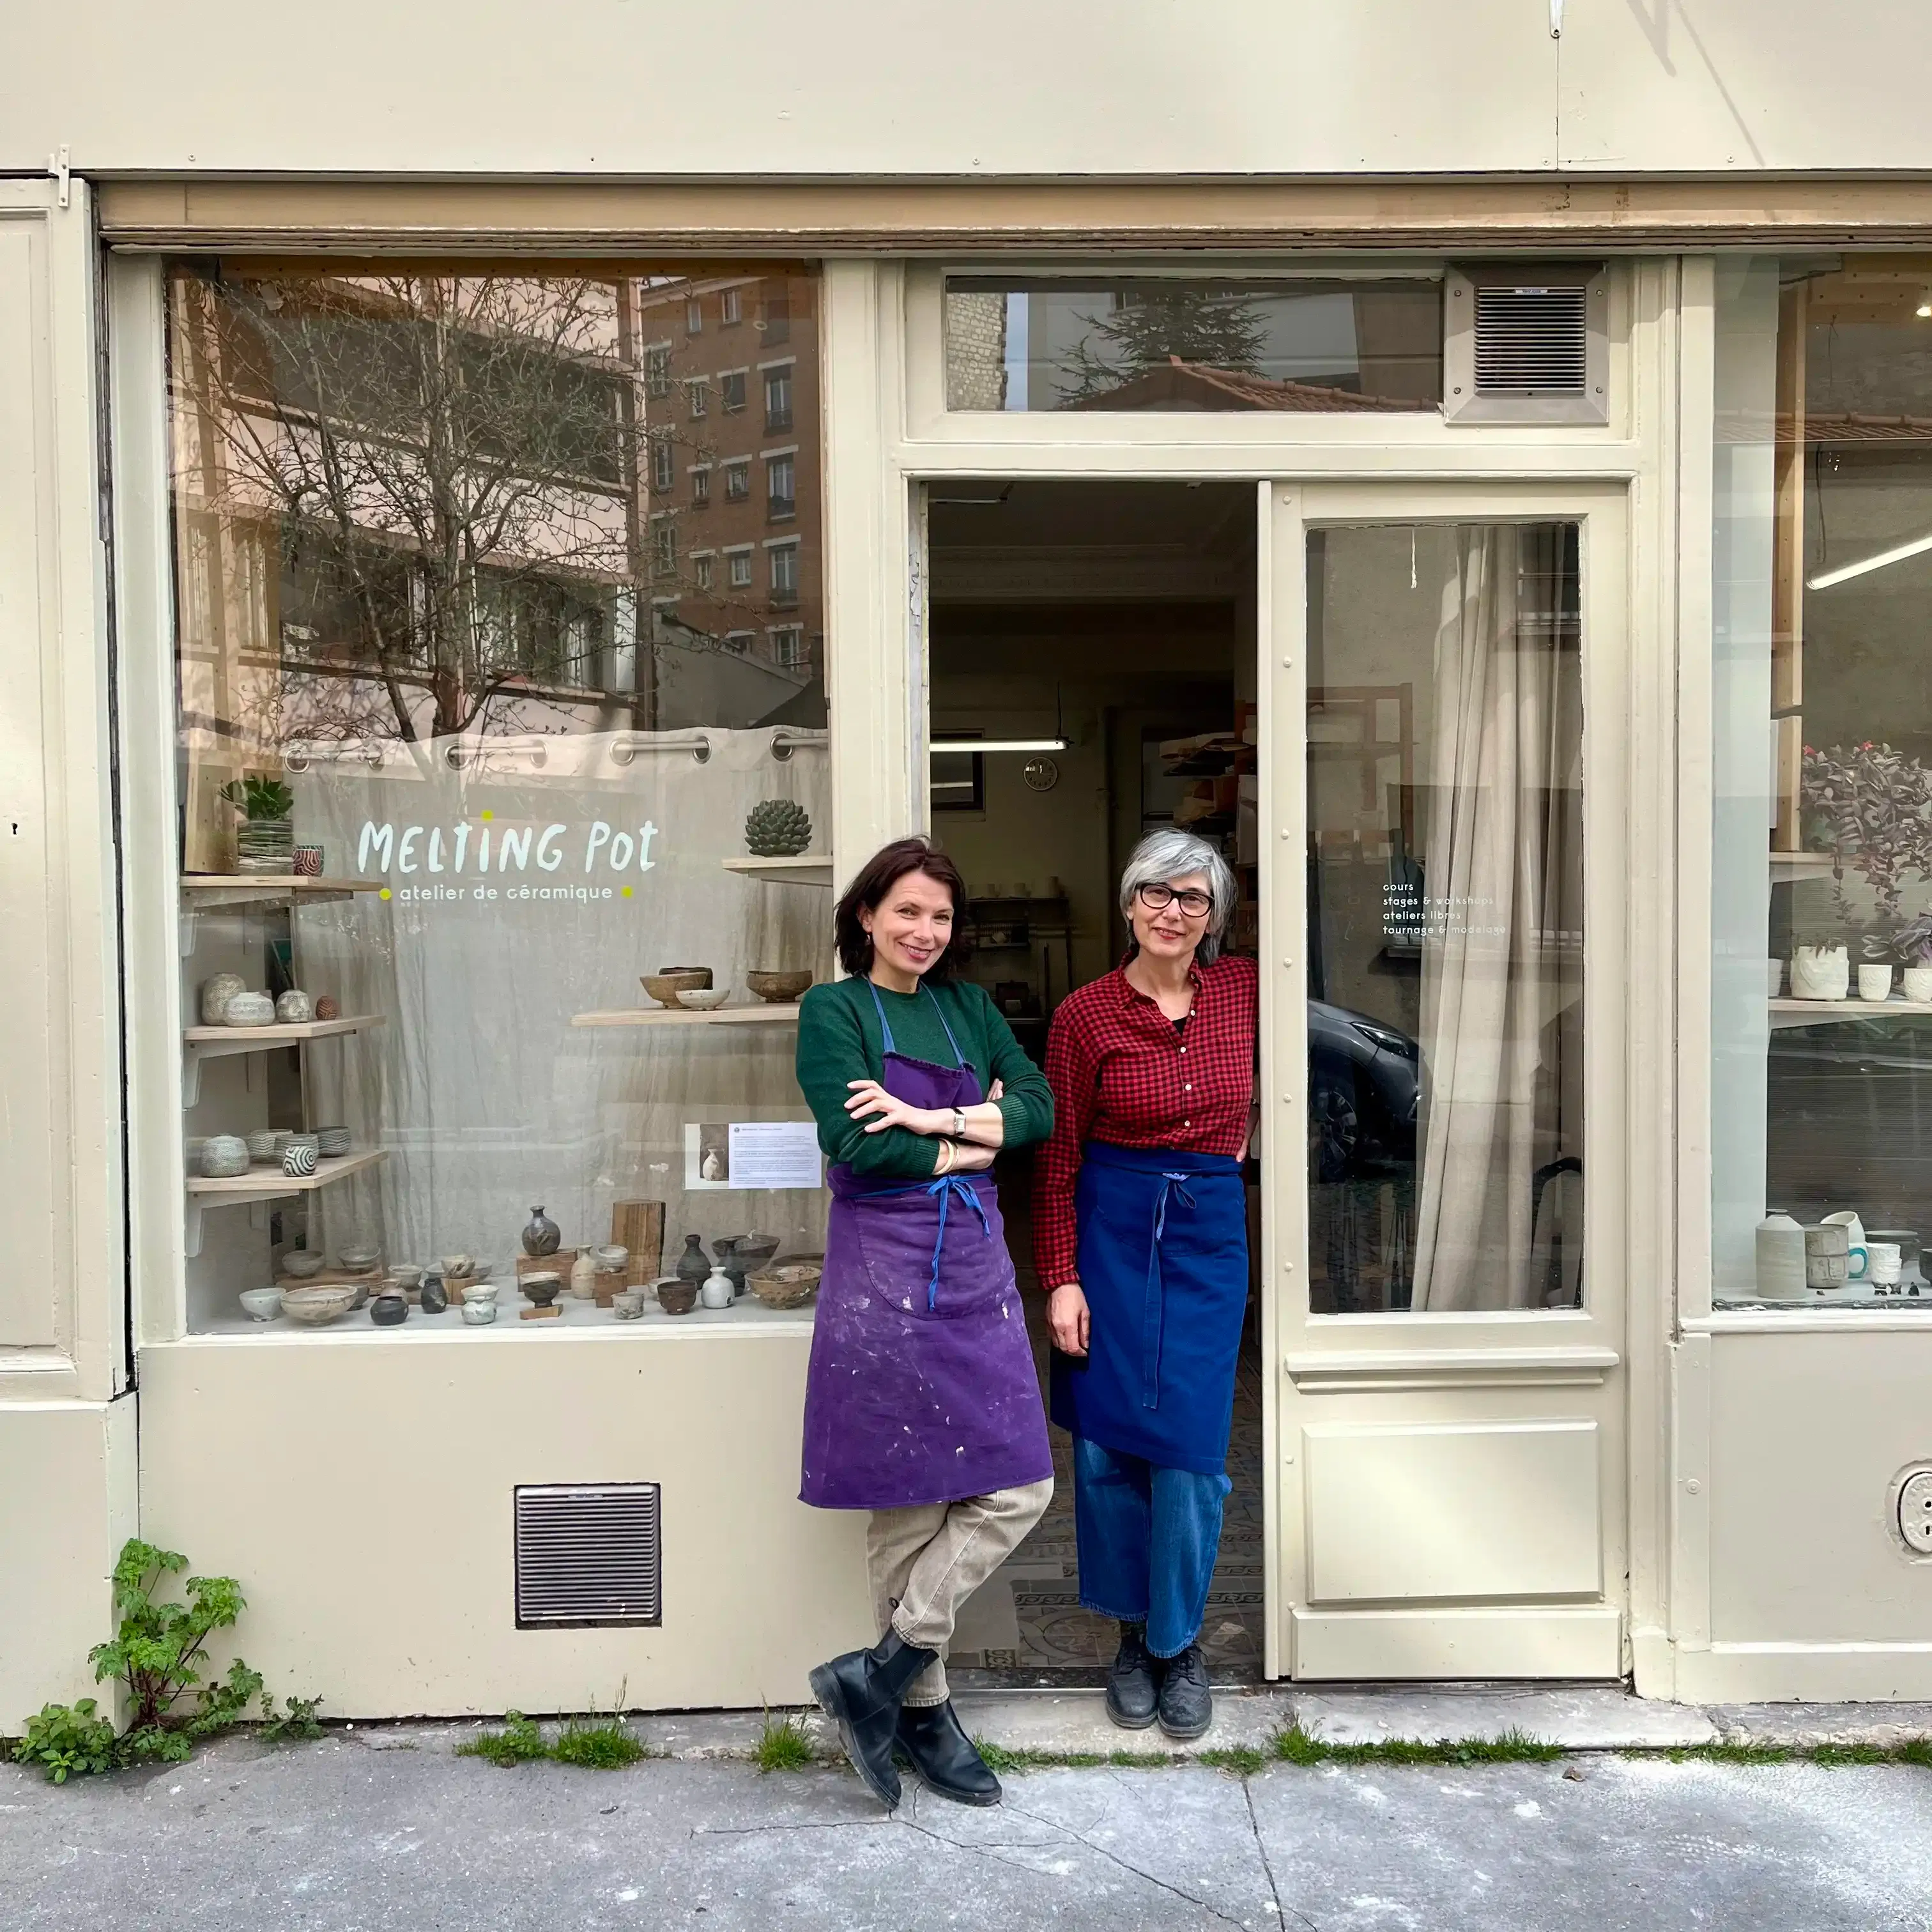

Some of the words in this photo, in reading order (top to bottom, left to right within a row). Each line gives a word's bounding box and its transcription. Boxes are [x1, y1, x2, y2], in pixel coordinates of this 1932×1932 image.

[1383, 883, 1414, 891] cours
[400, 884, 465, 900] atelier
[473, 884, 498, 900] de
[507, 884, 613, 903] céramique
[1383, 896, 1418, 908] stages
[1423, 896, 1431, 905] &
[1436, 896, 1494, 908] workshops
[1383, 910, 1426, 920] ateliers
[1430, 910, 1461, 920] libres
[1383, 925, 1434, 937] tournage
[1438, 924, 1446, 933] &
